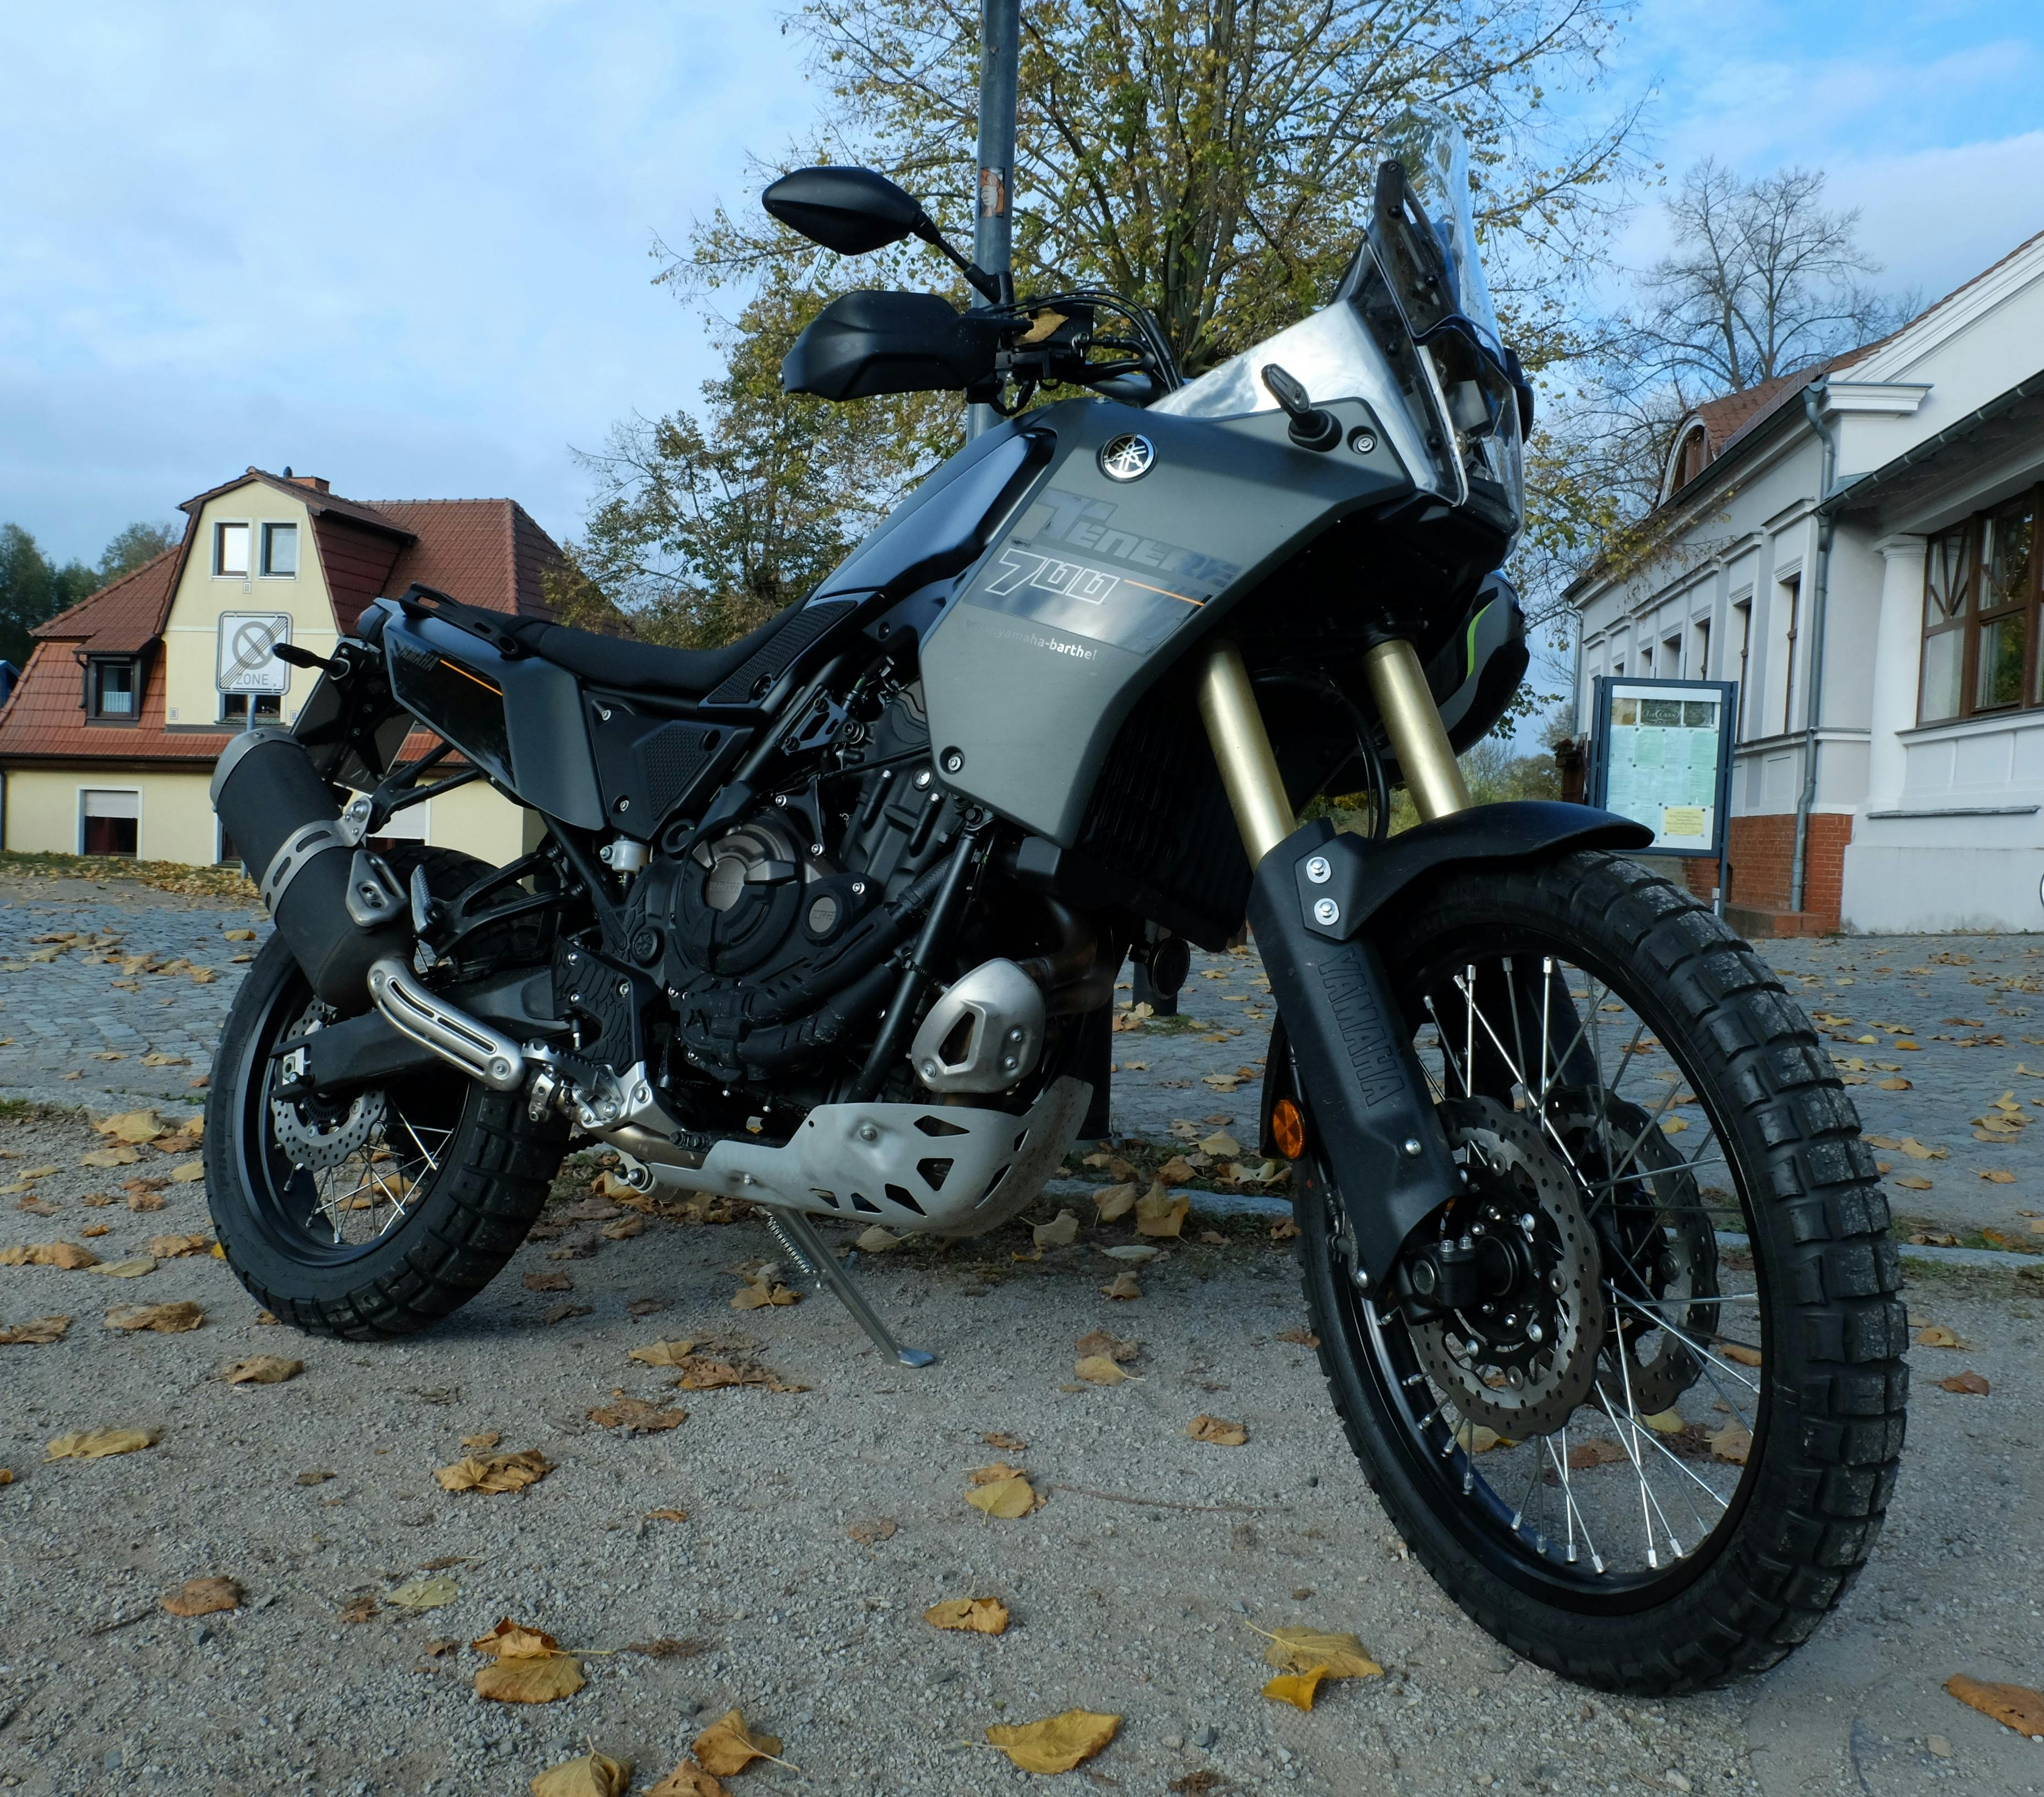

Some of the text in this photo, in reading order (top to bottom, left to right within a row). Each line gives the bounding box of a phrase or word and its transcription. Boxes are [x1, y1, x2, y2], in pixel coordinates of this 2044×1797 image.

[984, 548, 1121, 605] 700
[236, 673, 269, 685] ZONE
[1318, 946, 1405, 1107] YAMAHA
